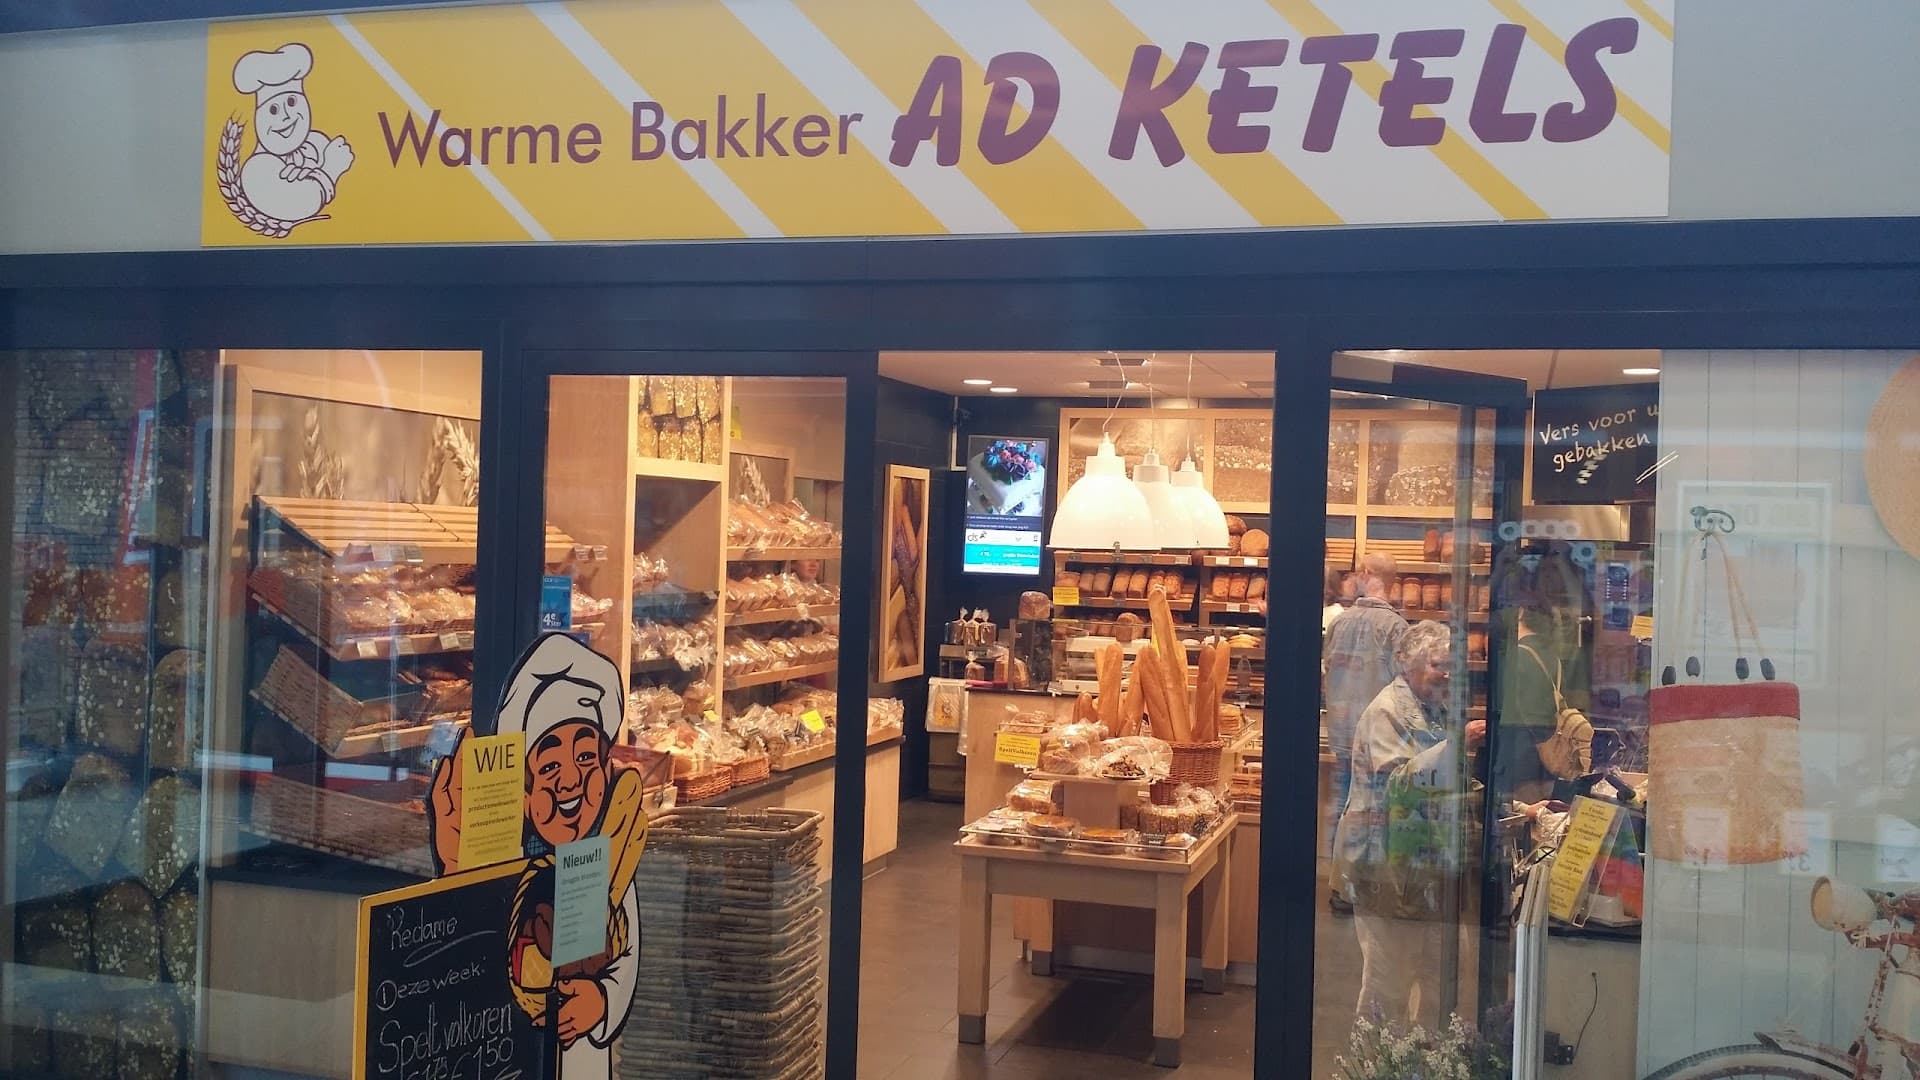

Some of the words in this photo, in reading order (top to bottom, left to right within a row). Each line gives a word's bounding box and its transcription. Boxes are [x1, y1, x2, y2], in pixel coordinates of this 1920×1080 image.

[378, 108, 602, 168] Warme
[631, 93, 863, 161] Bakker
[888, 51, 1061, 168] AD
[1108, 16, 1640, 168] KETELS
[1539, 424, 1580, 445] Vers
[1588, 408, 1636, 431] voor
[1552, 432, 1651, 472] gebakken
[474, 743, 515, 774] WIE
[562, 847, 602, 870] Nieuw!!
[387, 904, 458, 950] Reclame
